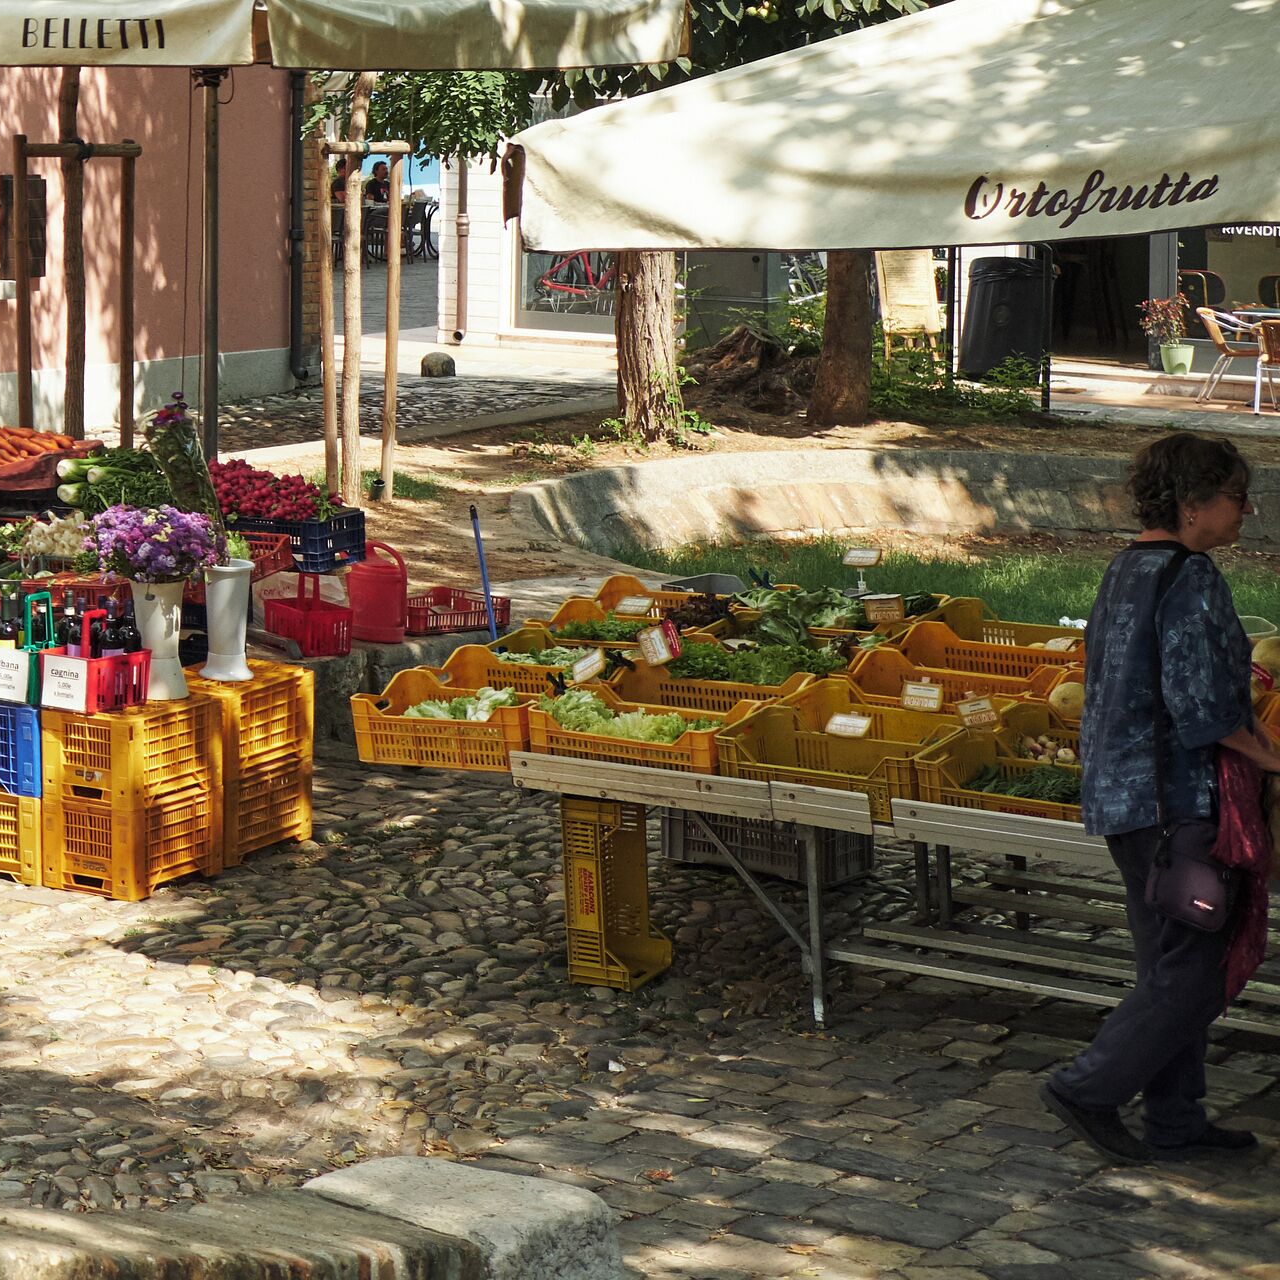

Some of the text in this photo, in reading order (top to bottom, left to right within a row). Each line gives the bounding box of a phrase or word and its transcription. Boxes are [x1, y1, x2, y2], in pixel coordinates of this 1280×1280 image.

[21, 17, 167, 49] BELLETTI
[963, 169, 1220, 229] Ortofrutta
[50, 667, 80, 679] cagnina
